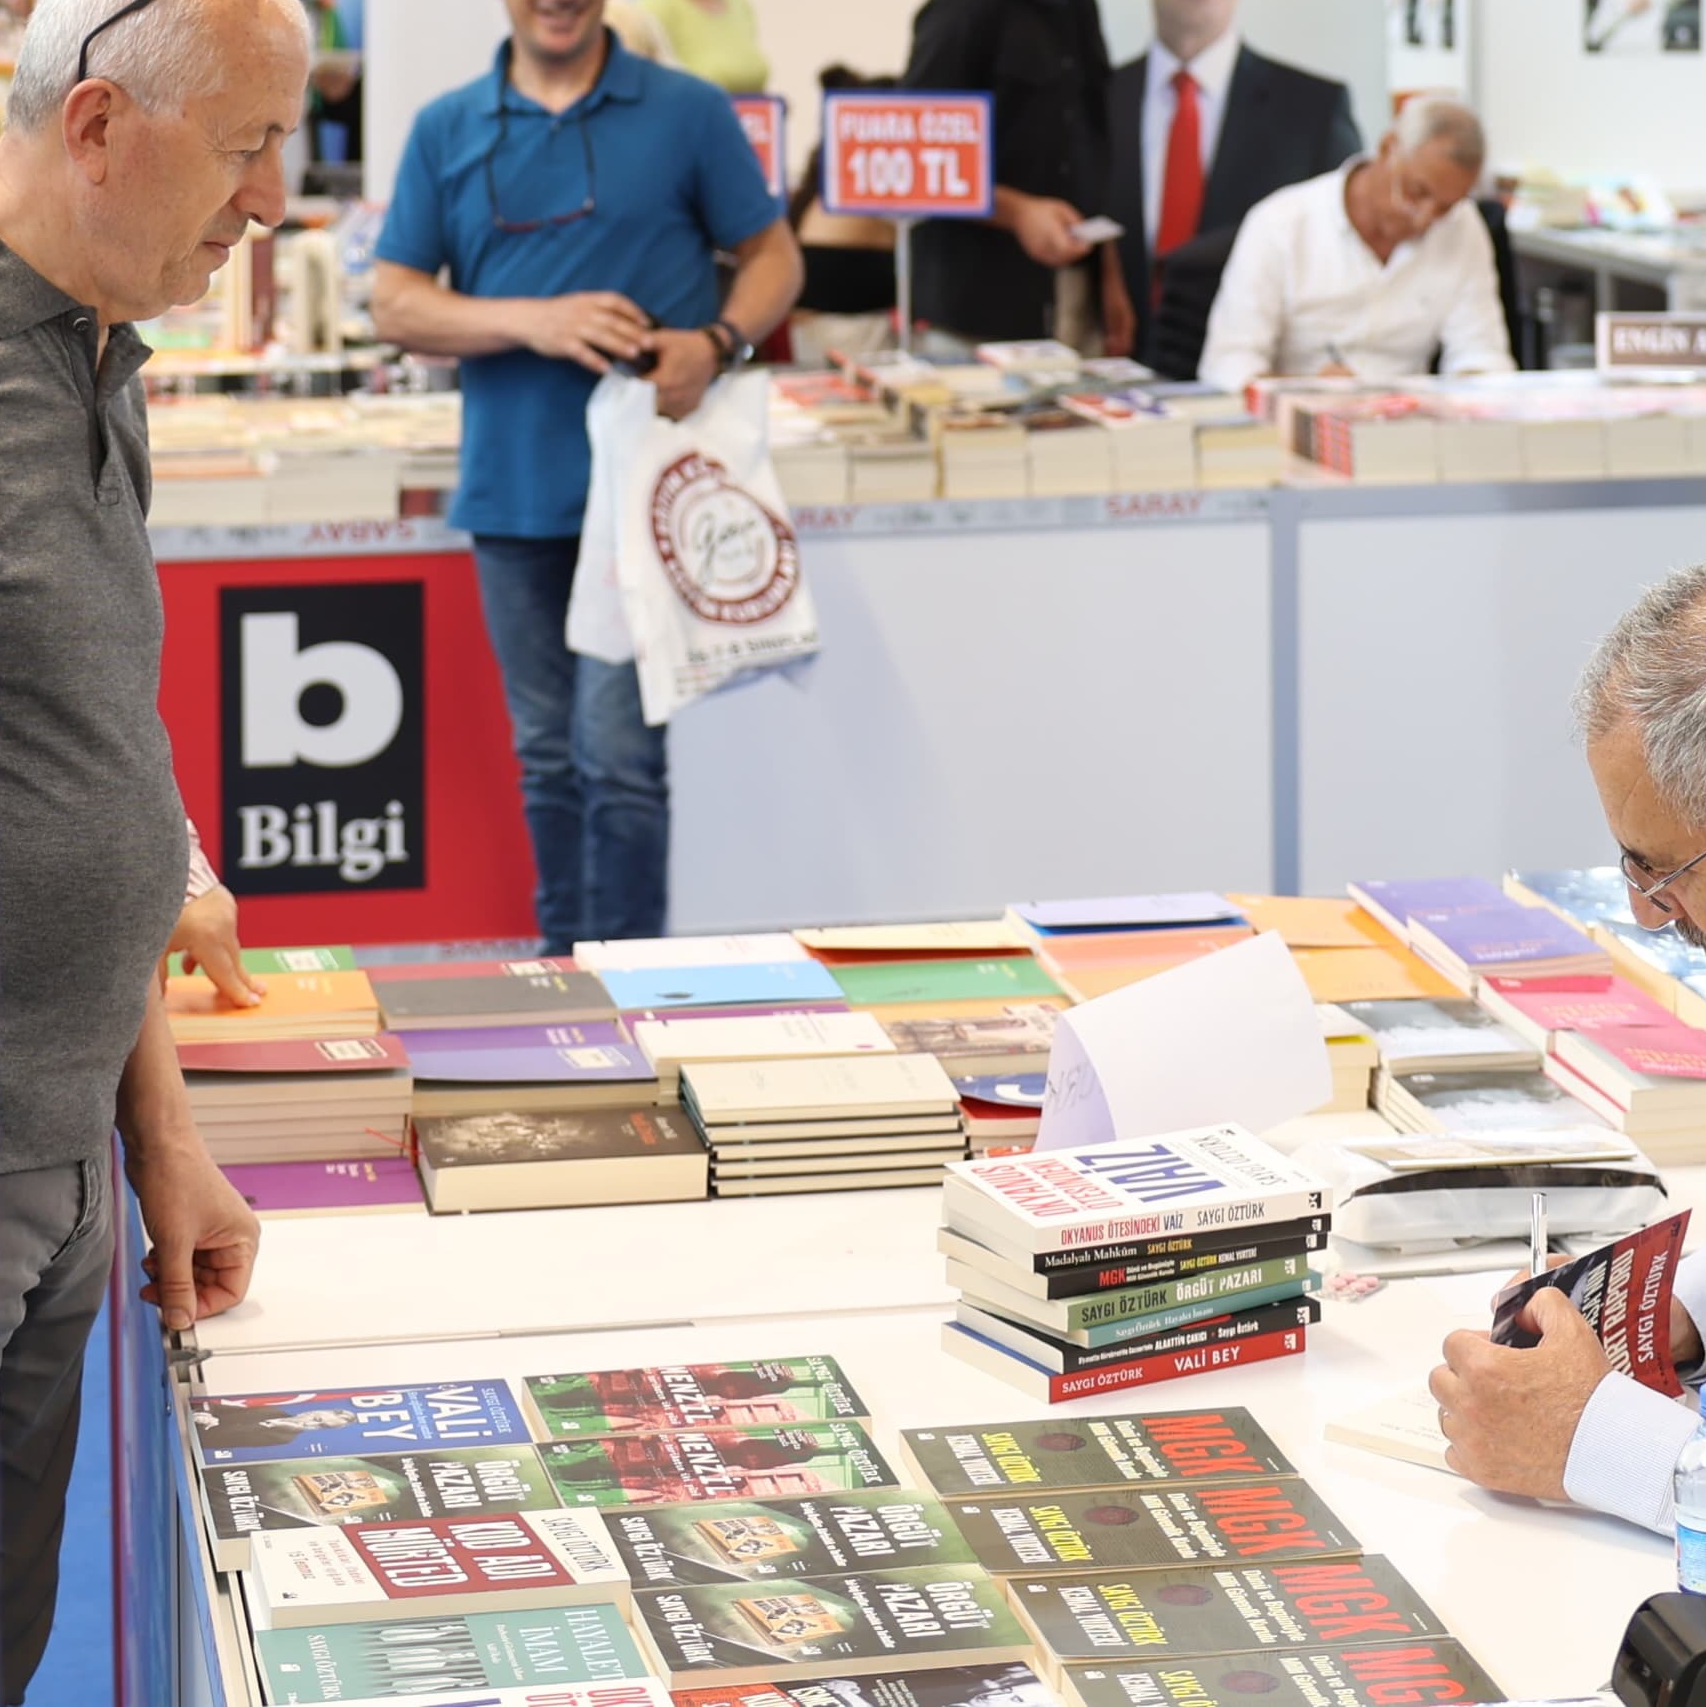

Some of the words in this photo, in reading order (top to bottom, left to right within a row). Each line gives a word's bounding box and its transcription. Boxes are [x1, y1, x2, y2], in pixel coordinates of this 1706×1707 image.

[848, 146, 915, 196] 100
[919, 147, 971, 196] TL
[795, 504, 860, 530] RAY
[240, 611, 404, 769] b
[238, 801, 407, 880] Bilgi
[1075, 1143, 1227, 1203] VAİZ
[1061, 1225, 1104, 1245] OKYANUS
[1108, 1217, 1160, 1239] ÖTESİNDEKİ
[1163, 1213, 1184, 1231] VAİZ
[1197, 1208, 1225, 1226] SAYGI
[1228, 1201, 1265, 1222] ÖZTÜRK
[1147, 1241, 1166, 1255] SAYGI
[1168, 1238, 1193, 1253] ÖZTÜRK
[1099, 1267, 1126, 1286] MGK
[1604, 1248, 1635, 1326] RAPORU
[1639, 1251, 1669, 1311] ÖZTÜRK
[1082, 1304, 1115, 1323] SAYGI
[1119, 1289, 1167, 1314] ÖZTÜRK
[1176, 1276, 1215, 1301] ÖRGÜT
[1219, 1268, 1263, 1292] PAZARI
[1638, 1315, 1655, 1363] SAYGI
[1062, 1378, 1095, 1394] SAYGI
[1097, 1367, 1144, 1386] ÖZTÜRK
[1174, 1349, 1206, 1372] VALİ
[1212, 1346, 1241, 1366] BEY
[421, 1385, 493, 1439] VALİ
[653, 1363, 728, 1424] MENZİL
[349, 1393, 418, 1443] BEY
[672, 1431, 747, 1493] MENZİL
[978, 1432, 1022, 1455] SAYGI
[1137, 1414, 1264, 1476] MGK
[220, 1470, 251, 1495] SAYGI
[426, 1460, 483, 1509] PAZARI
[470, 1458, 537, 1504] ÖRGÜT
[993, 1455, 1045, 1483] ÖZTÜRK
[227, 1495, 268, 1531] ÖZTÜRK
[540, 1516, 589, 1540] SAYGI
[617, 1516, 655, 1541] SAYGI
[828, 1505, 894, 1556] PAZARI
[873, 1503, 947, 1549] ÖRGÜT
[989, 1508, 1034, 1534] KEMAL
[1025, 1505, 1075, 1531] SAYGI
[1192, 1486, 1330, 1555] MGK
[446, 1519, 532, 1551] KOD
[1005, 1533, 1055, 1563] YURTERİ
[1043, 1530, 1096, 1561] ÖZTÜRK
[356, 1525, 470, 1589] MÜRTED
[472, 1552, 557, 1581] ADI
[559, 1540, 614, 1572] ÖZTÜRK
[631, 1543, 680, 1580] ÖZTÜRK
[1093, 1583, 1145, 1610] SAYGI
[1236, 1569, 1273, 1591] Dünü
[1254, 1591, 1278, 1600] ve
[653, 1594, 694, 1624] SAYGI
[872, 1581, 946, 1638] PAZARI
[919, 1580, 1000, 1631] ÖRGÜT
[1053, 1586, 1104, 1613] KEMAL
[1219, 1587, 1266, 1618] Güvenlik
[1267, 1563, 1415, 1639] MGK
[1072, 1613, 1129, 1646] YURTERİ
[1111, 1610, 1173, 1645] ÖZTÜRK
[1242, 1618, 1280, 1643] Kurulu
[1256, 1601, 1312, 1641] Bugünüyle
[306, 1633, 332, 1659] SAYGI
[515, 1626, 576, 1673] İMAM
[560, 1609, 628, 1682] HAYALET
[668, 1623, 720, 1662] ÖZTÜRK
[313, 1659, 346, 1699] ÖZTÜRK
[1154, 1669, 1208, 1698] SAYGI
[1304, 1655, 1341, 1677] Dünü
[1321, 1677, 1348, 1688] ve
[1334, 1647, 1472, 1705] MG
[1112, 1672, 1165, 1700] KEMAL
